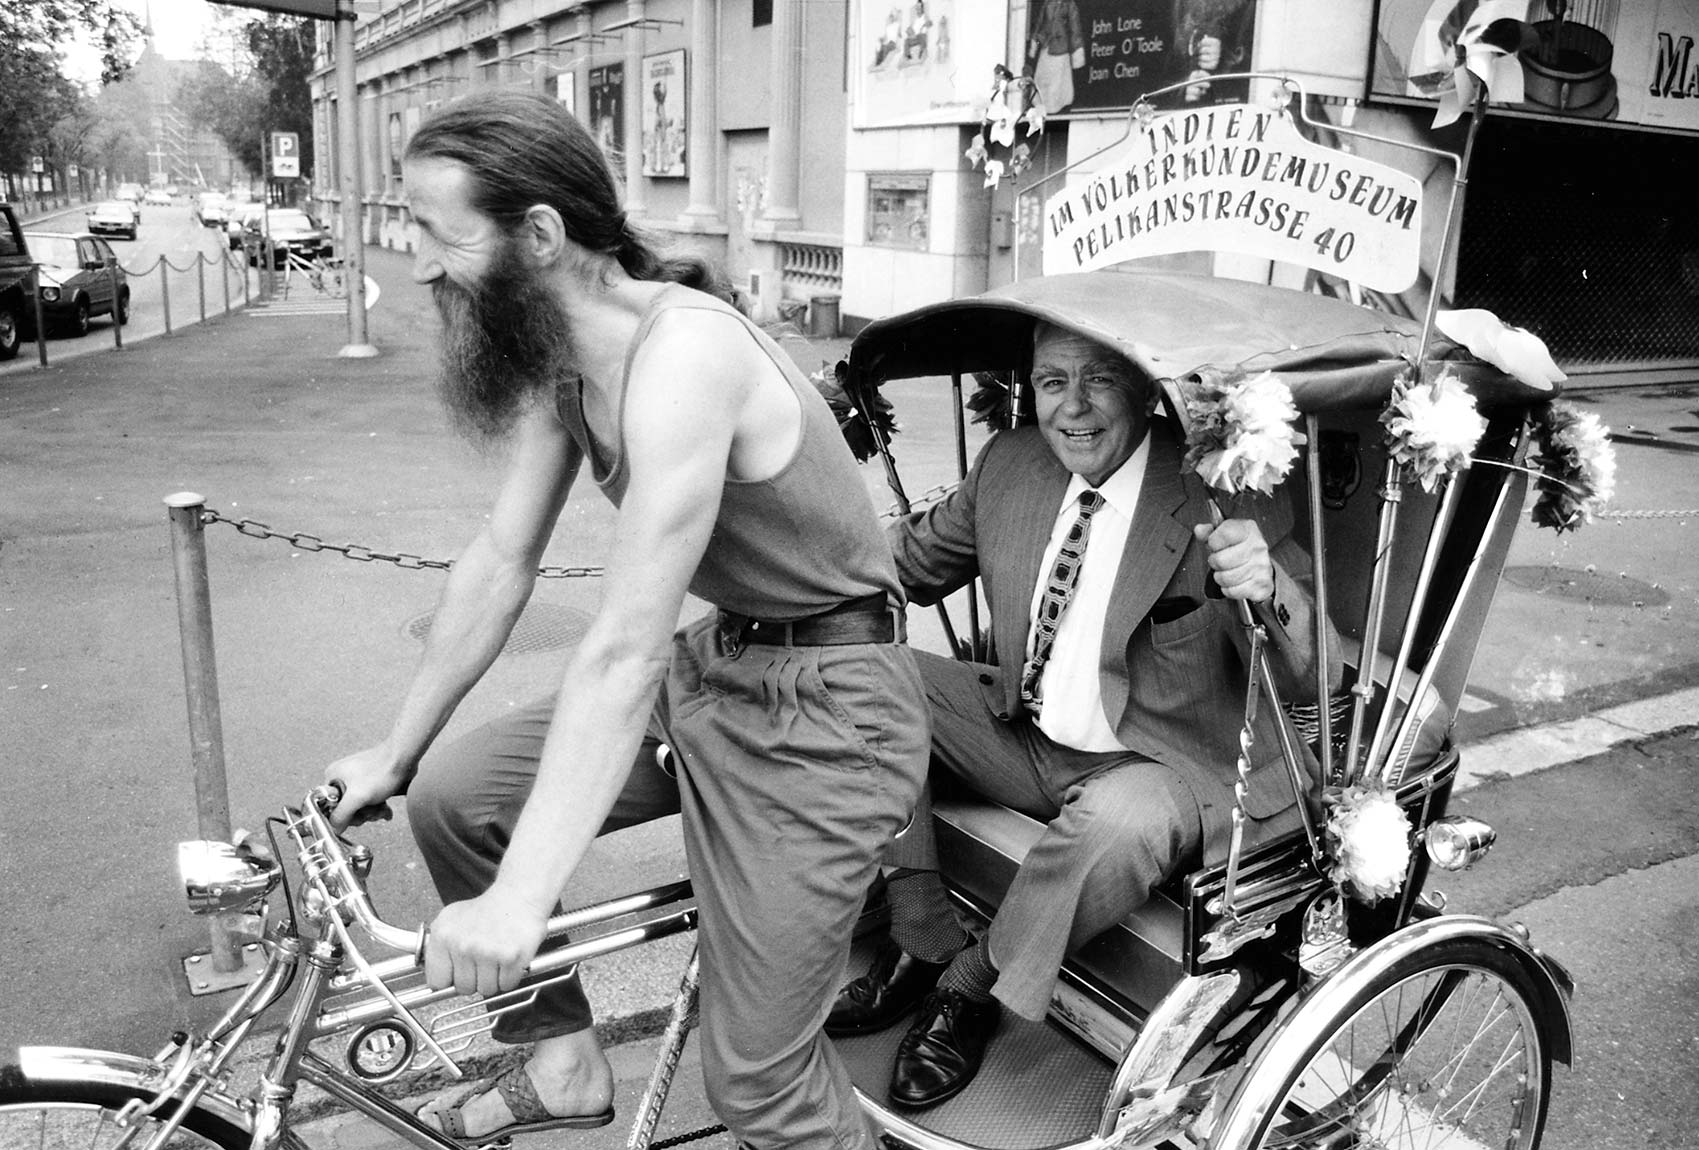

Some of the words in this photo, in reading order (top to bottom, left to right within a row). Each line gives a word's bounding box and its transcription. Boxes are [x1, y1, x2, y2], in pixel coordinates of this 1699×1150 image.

[1091, 19, 1112, 38] John
[1117, 16, 1142, 32] Lone
[1091, 42, 1116, 57] Peter
[1088, 66, 1108, 83] Joan
[1114, 62, 1139, 79] Chen
[1148, 109, 1271, 155] INDIEN
[279, 137, 293, 156] P
[1050, 201, 1074, 238] IM
[1081, 143, 1418, 230] VÖLKERKUNDEMUSEUM
[1072, 189, 1310, 266] PELIKANSTRASSE
[1313, 227, 1355, 263] 40
